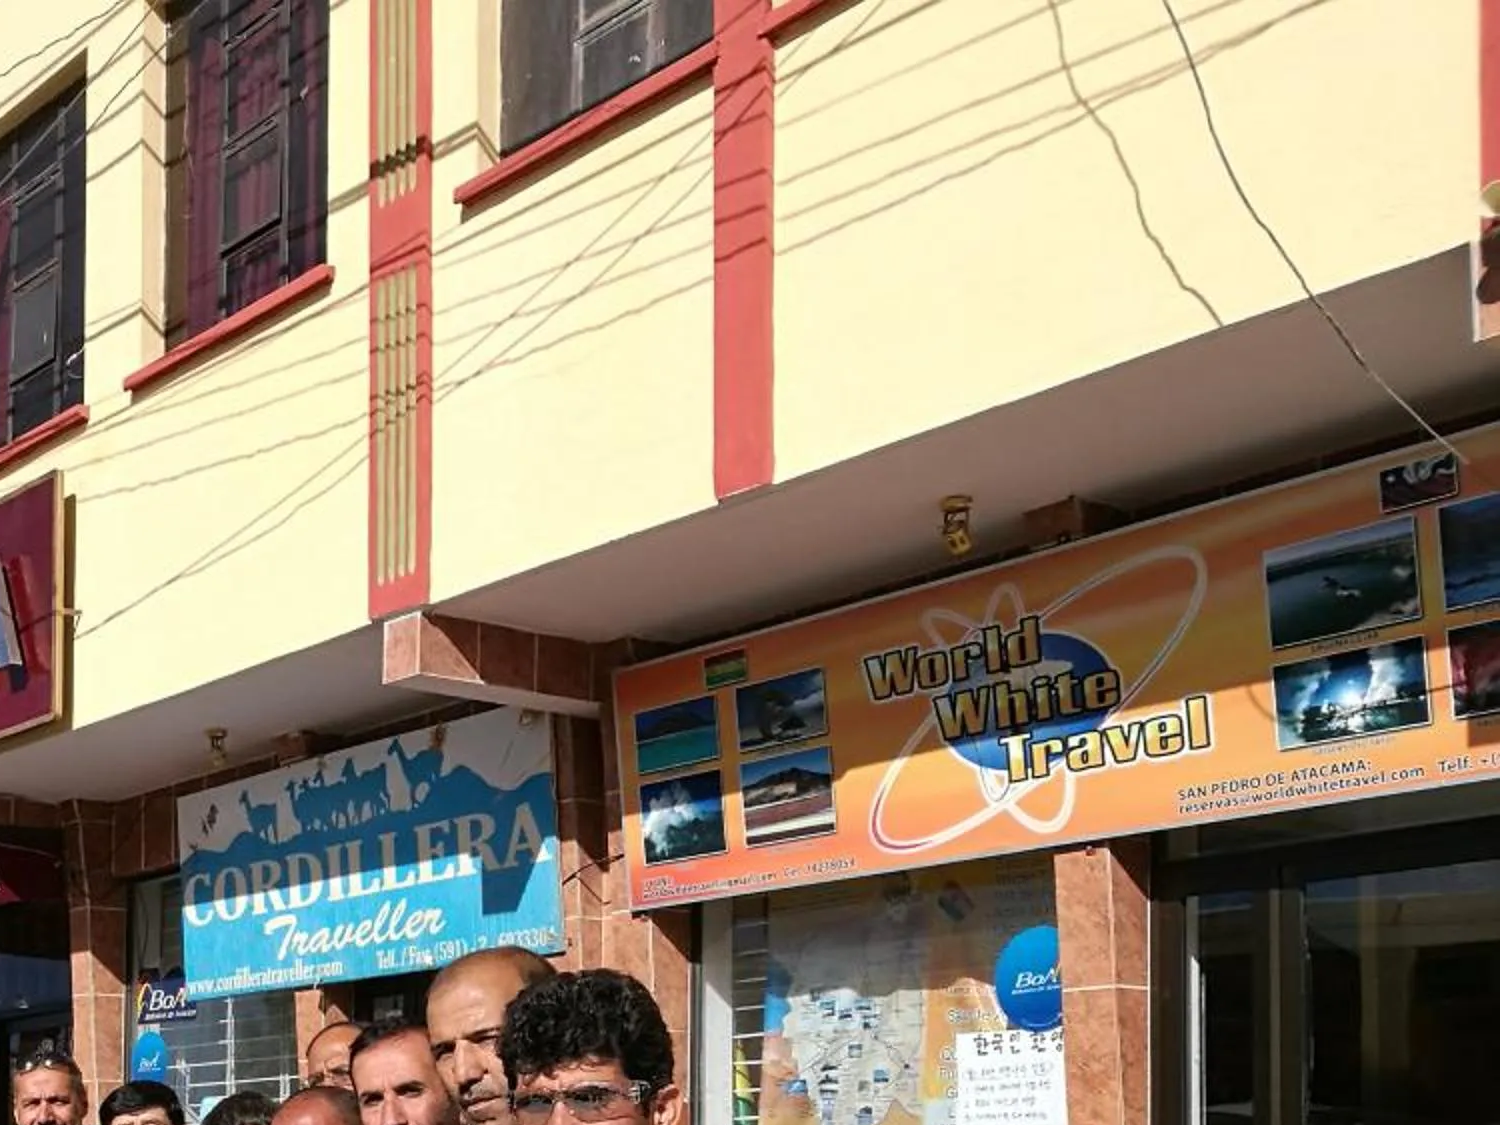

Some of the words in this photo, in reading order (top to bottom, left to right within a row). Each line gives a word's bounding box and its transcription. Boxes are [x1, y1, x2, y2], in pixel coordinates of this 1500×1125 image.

[864, 615, 1043, 700] World
[932, 669, 1121, 742] White
[1000, 696, 1212, 783] Travel
[1178, 785, 1207, 801] SAN
[1211, 777, 1261, 795] PEDRO
[1265, 772, 1285, 786] DE
[1291, 759, 1372, 782] ATACAMA:
[182, 801, 553, 928] CORDILLERA
[264, 898, 446, 962] Traveller
[149, 987, 187, 1011] BoA
[185, 958, 344, 995] www.cordilleratraveller.com
[1015, 966, 1060, 990] BoA
